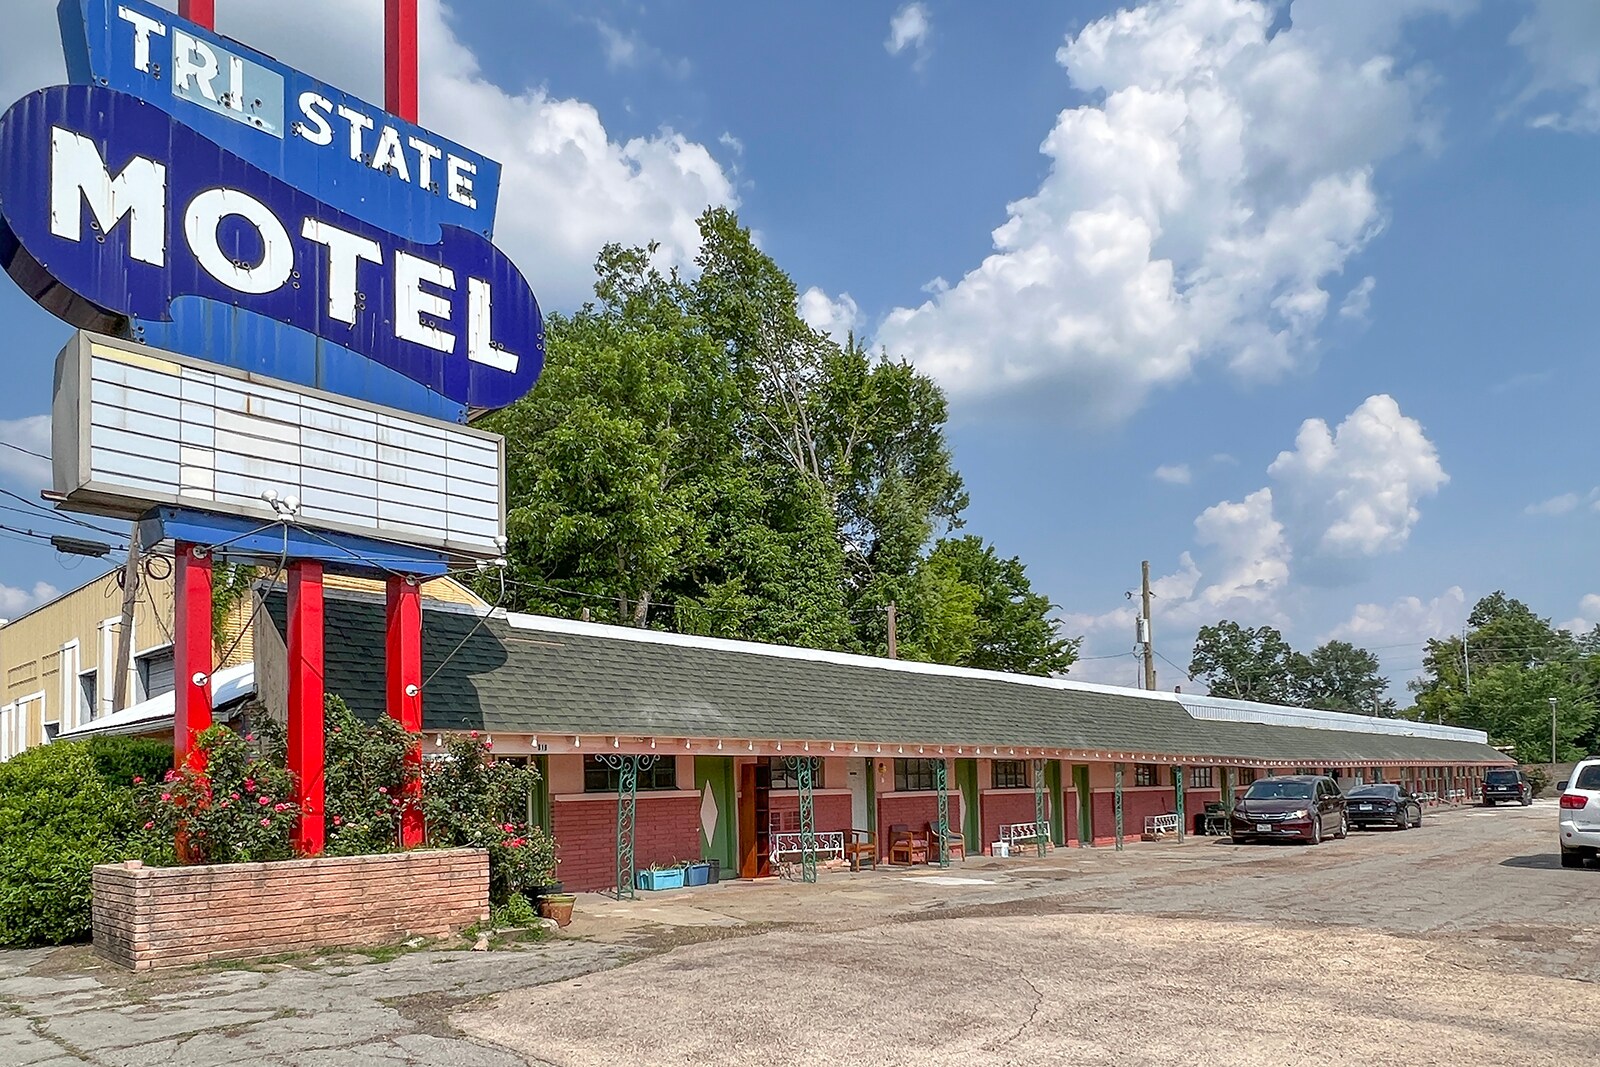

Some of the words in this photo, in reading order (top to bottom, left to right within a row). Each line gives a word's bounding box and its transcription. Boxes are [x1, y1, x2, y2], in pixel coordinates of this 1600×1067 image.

[118, 5, 243, 112] TRI
[298, 91, 477, 209] STATE
[50, 126, 519, 374] MOTEL
